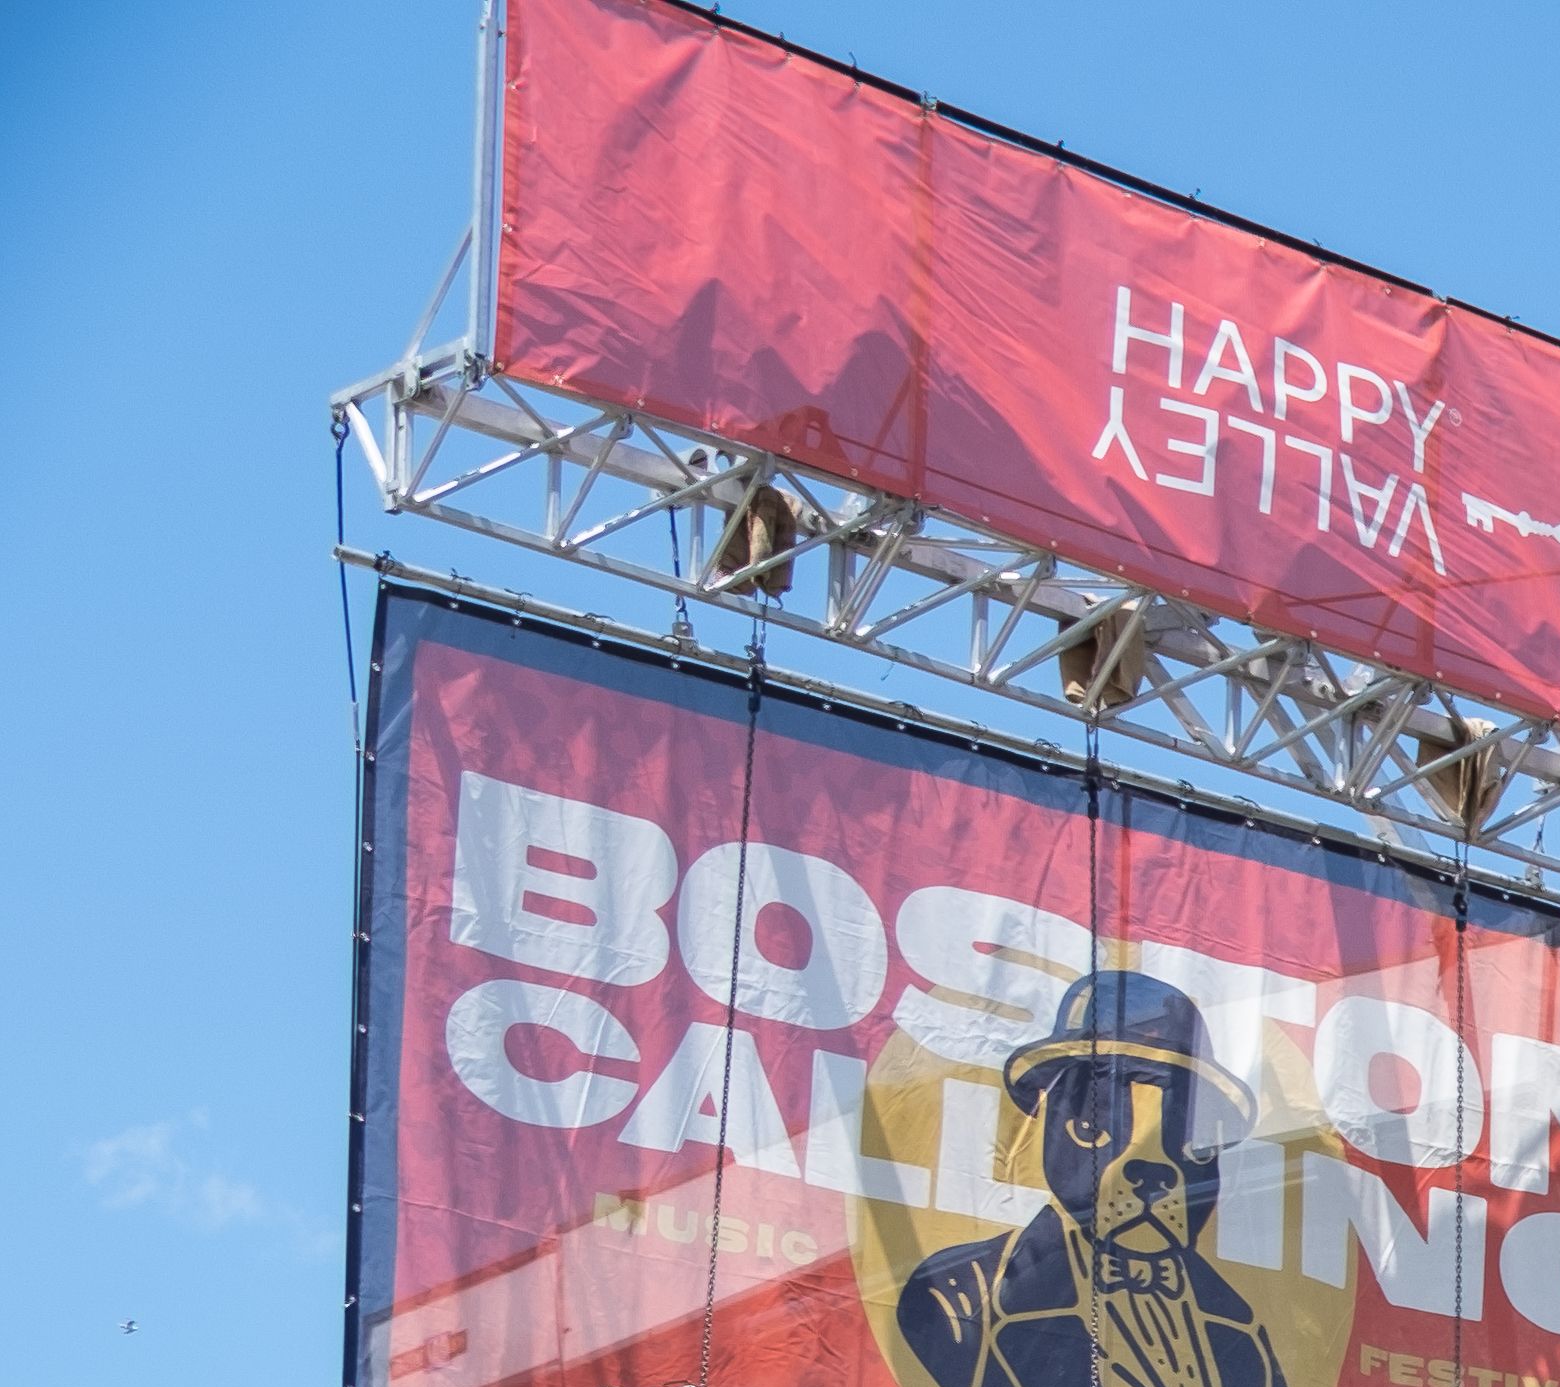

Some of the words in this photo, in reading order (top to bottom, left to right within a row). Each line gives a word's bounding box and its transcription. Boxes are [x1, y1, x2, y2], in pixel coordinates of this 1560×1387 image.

[1112, 286, 1446, 474] HAPPY
[1092, 386, 1447, 576] VALLEY
[593, 1191, 818, 1265] MUSIC
